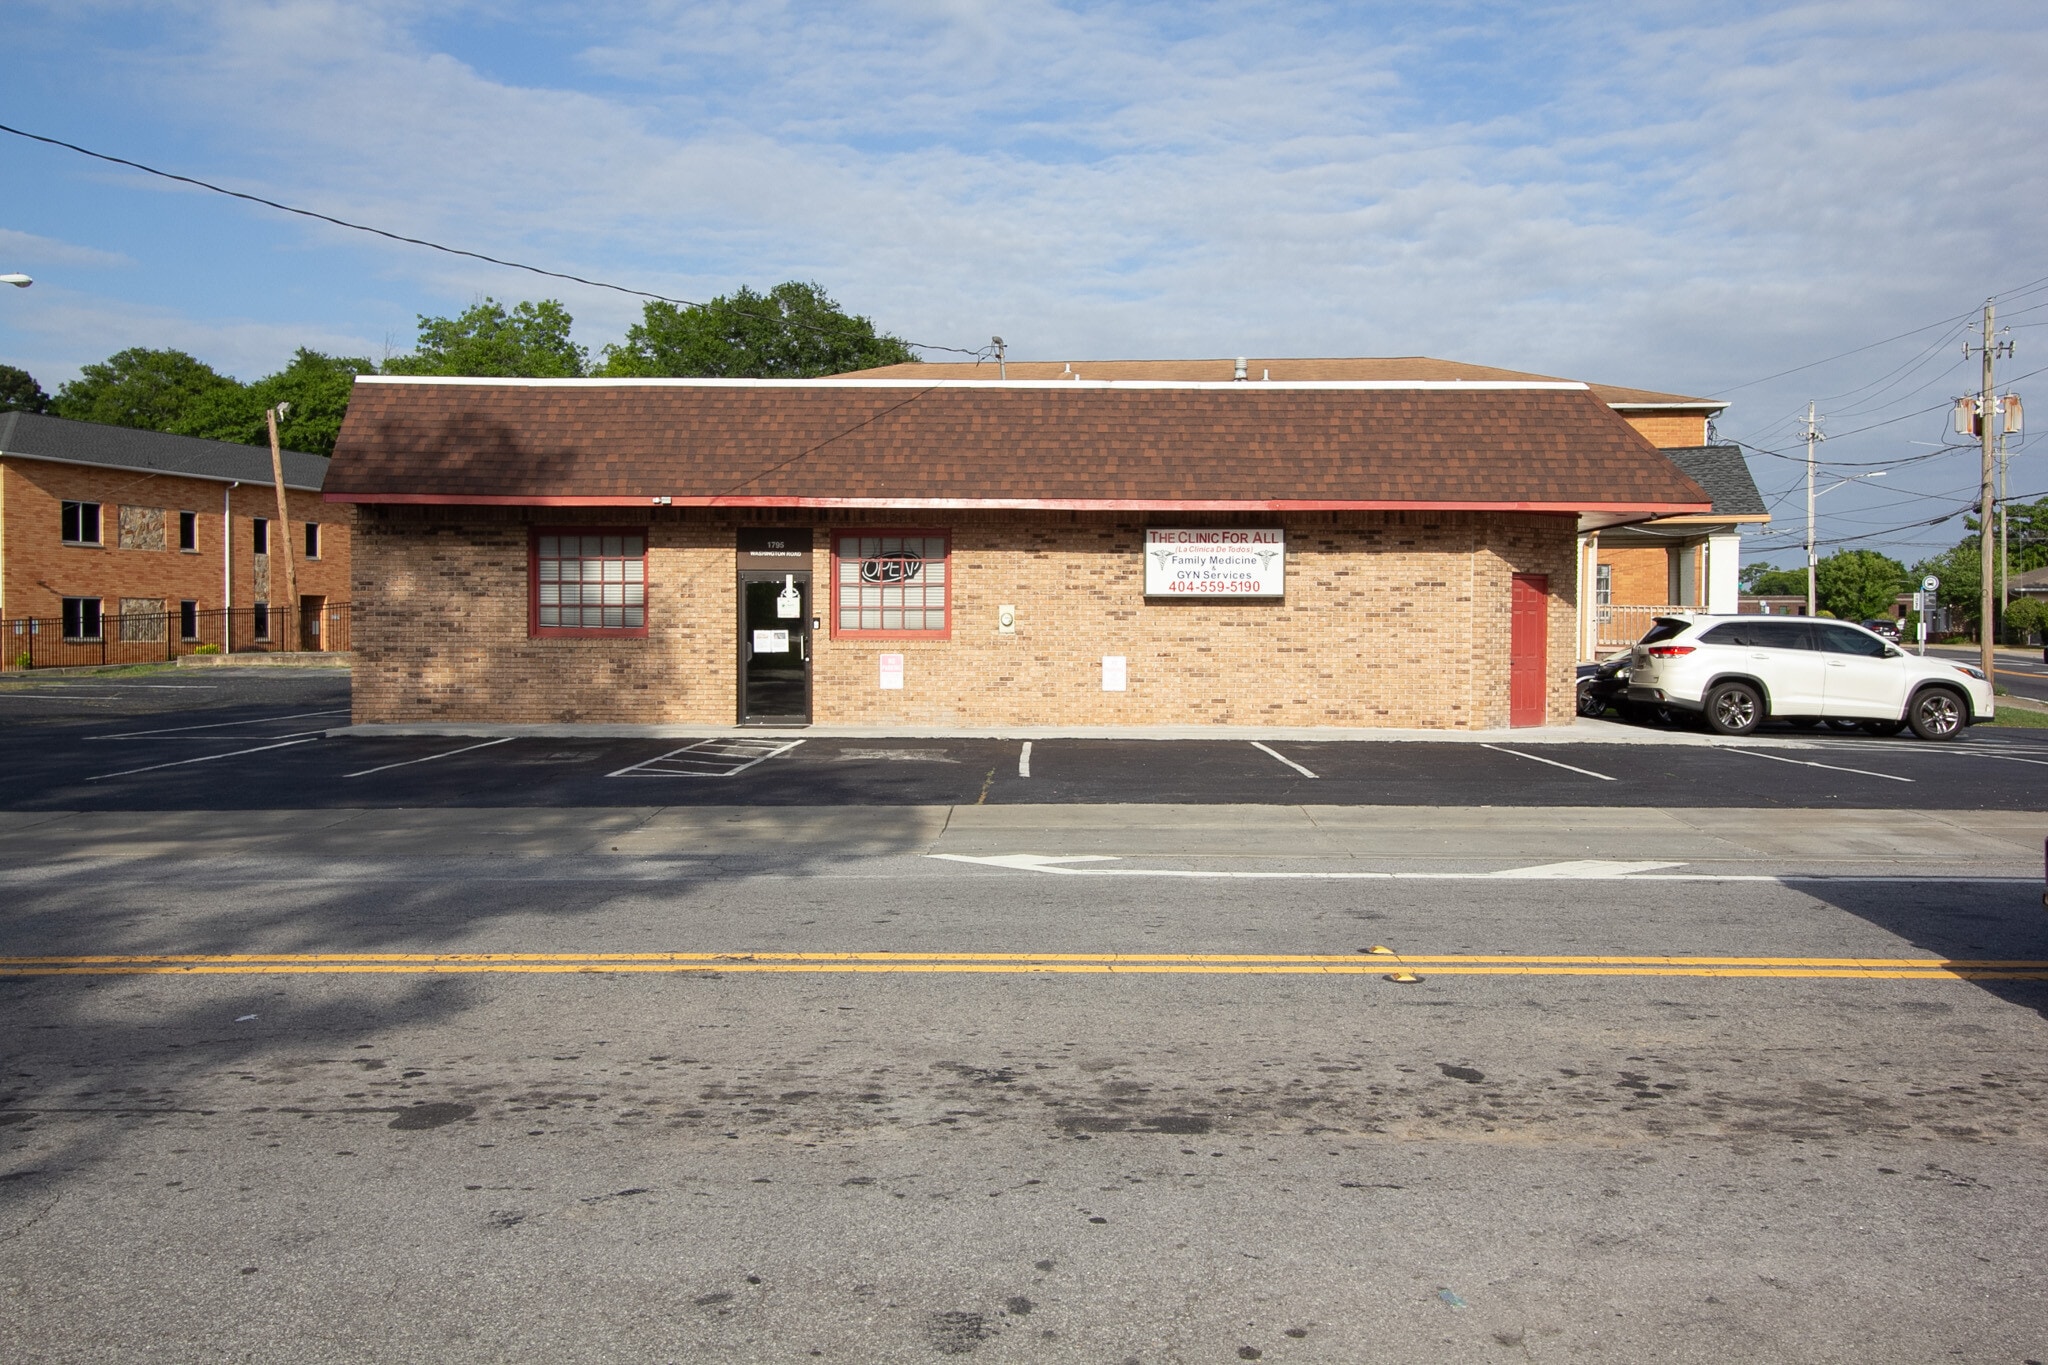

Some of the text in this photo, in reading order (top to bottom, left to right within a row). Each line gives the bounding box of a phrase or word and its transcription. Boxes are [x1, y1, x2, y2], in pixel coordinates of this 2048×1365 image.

[1150, 531, 1279, 544] THE CLINIC FOR ALL
[767, 541, 785, 549] 1795
[1175, 546, 1187, 554] (La
[1228, 546, 1254, 554] Todos)
[1171, 556, 1257, 566] Family Medicine
[864, 559, 915, 577] OPEN
[1177, 571, 1252, 580] GYN Services
[1169, 581, 1260, 592] 404-559-5190
